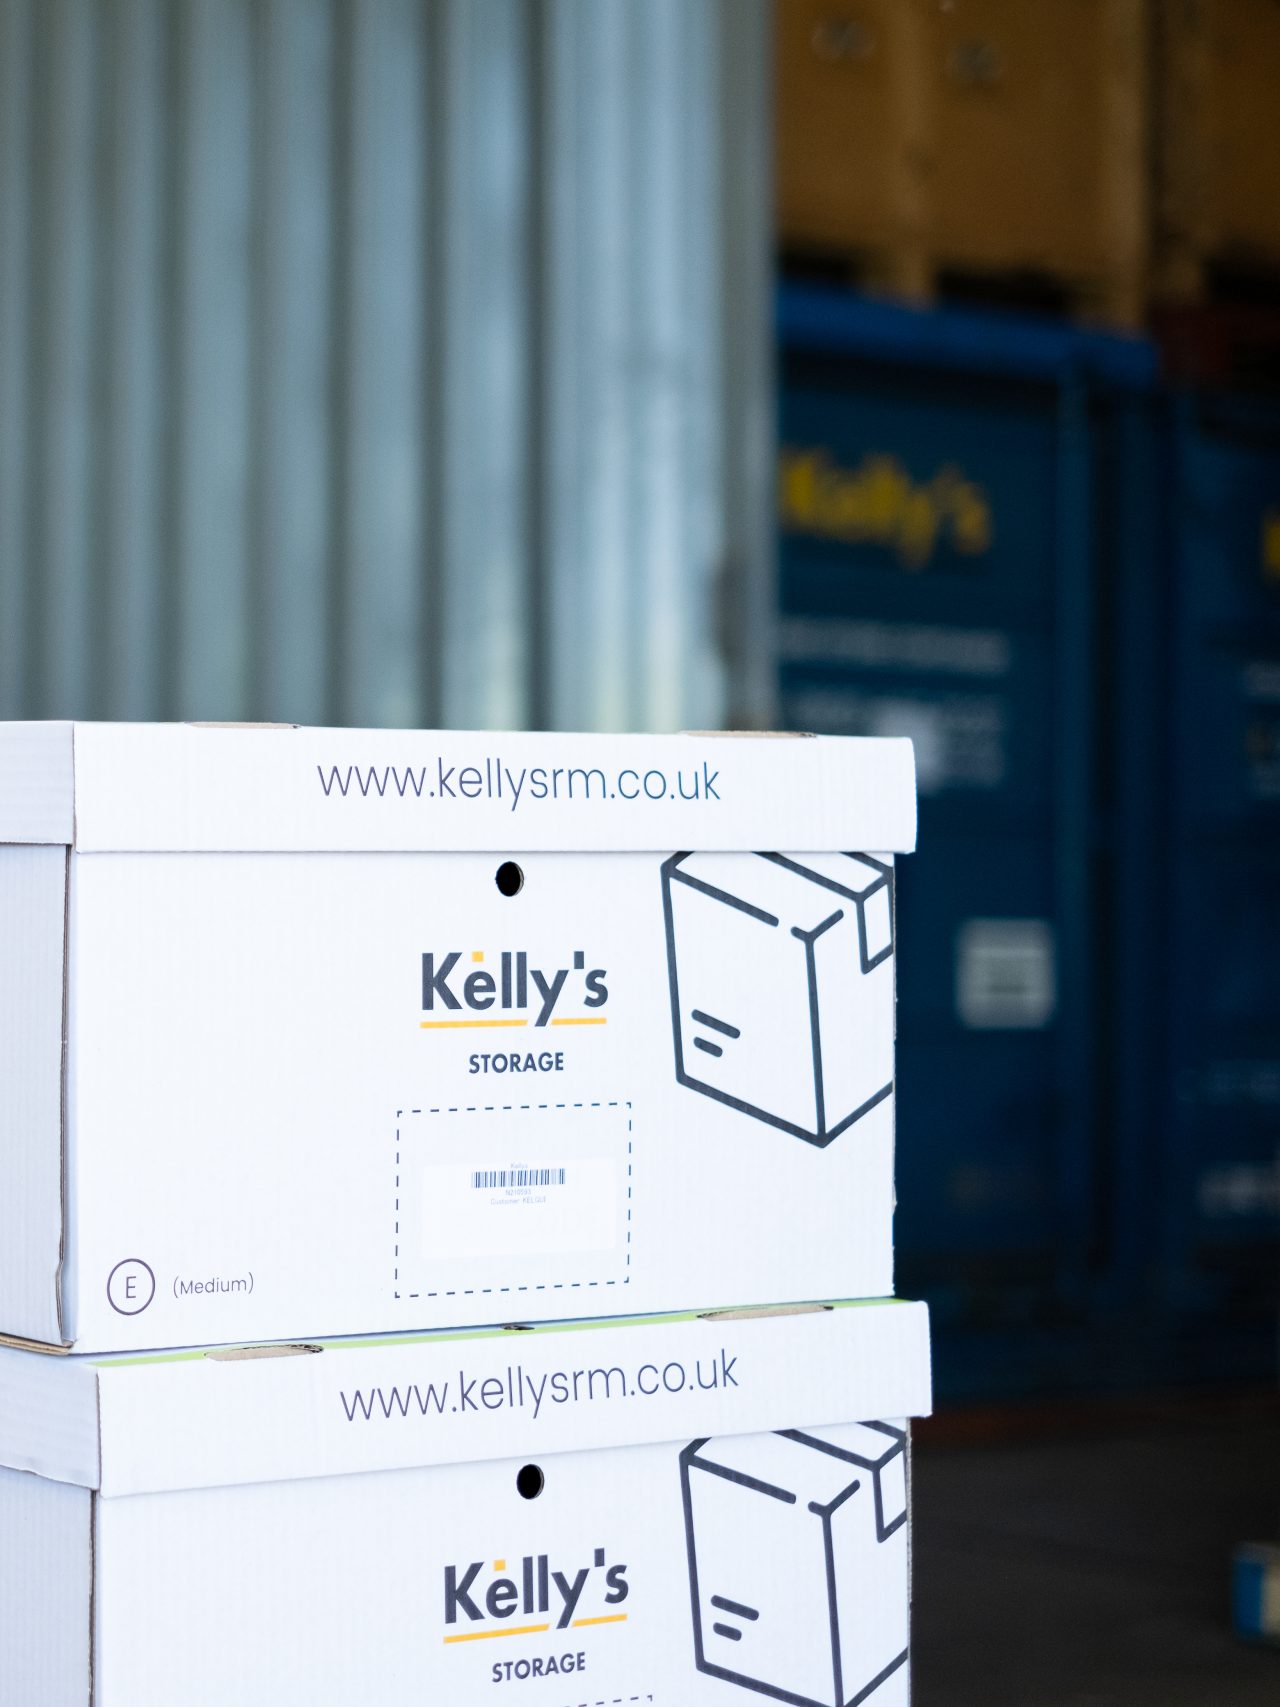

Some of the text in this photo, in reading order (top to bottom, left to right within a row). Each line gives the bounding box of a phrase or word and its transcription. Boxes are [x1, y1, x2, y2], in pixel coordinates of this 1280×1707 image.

[316, 756, 721, 812] www.kellysrm.co.uk
[421, 950, 610, 1027] Kelly's
[468, 1051, 565, 1075] STORAGE
[124, 1271, 255, 1299] E (Medium)
[339, 1348, 739, 1422] www.kellysrm.co.uk
[443, 1546, 630, 1630] Kelly's
[491, 1651, 586, 1683] STORAGE
